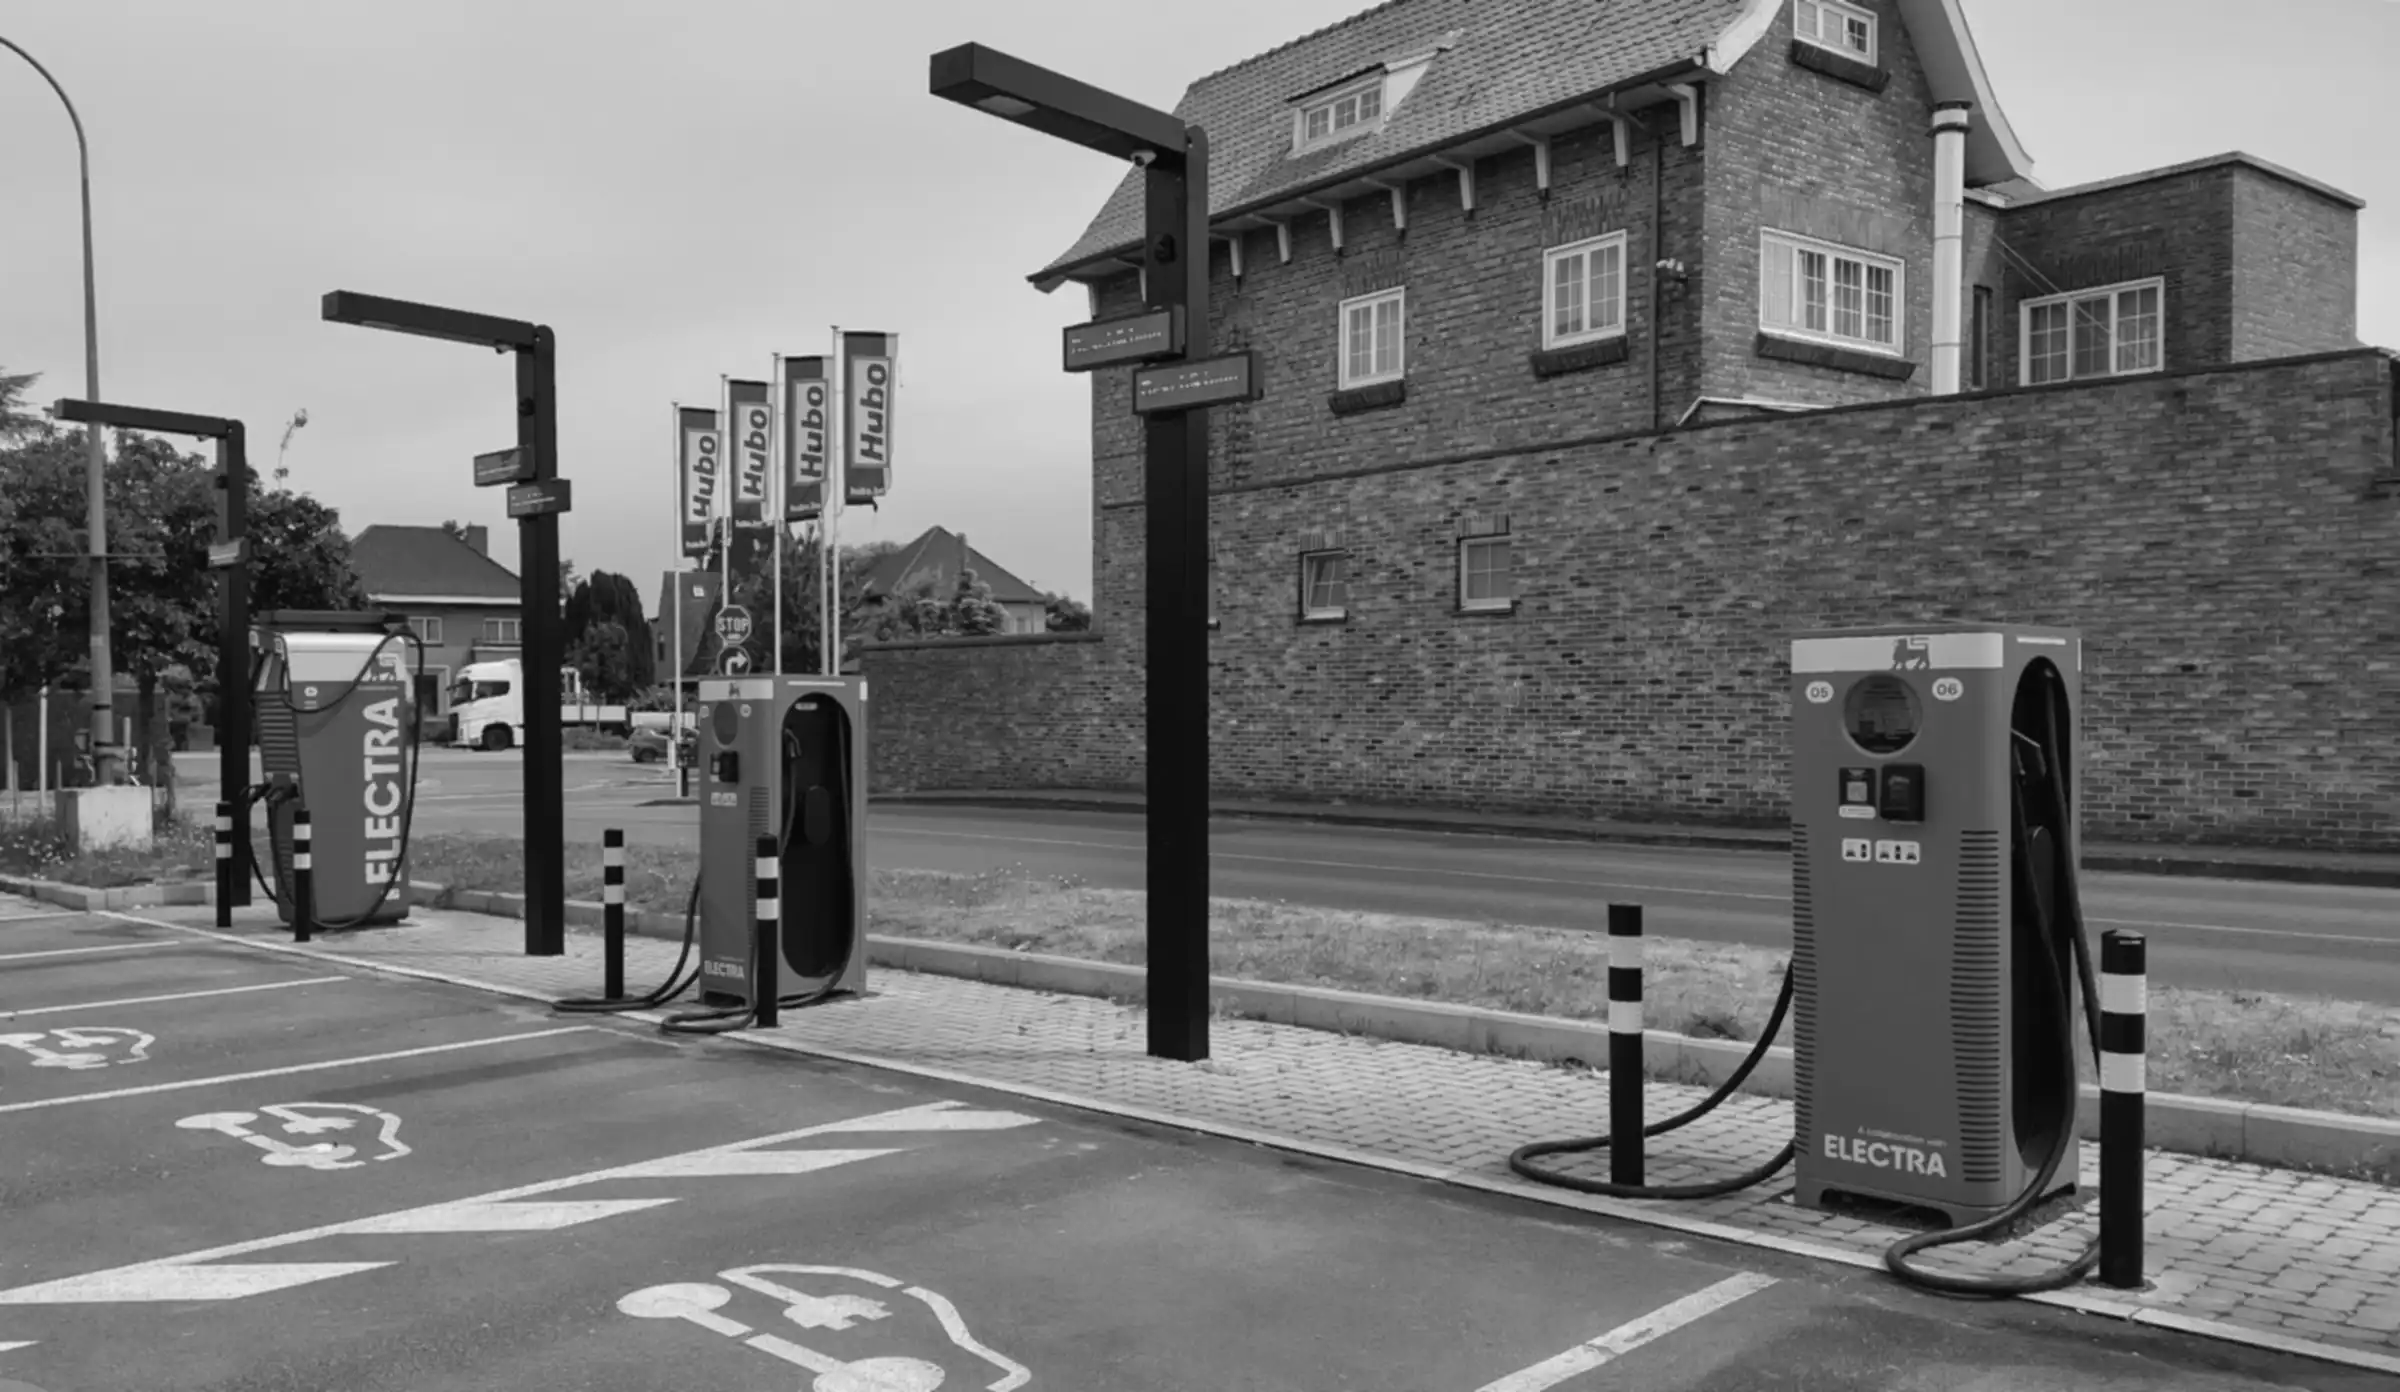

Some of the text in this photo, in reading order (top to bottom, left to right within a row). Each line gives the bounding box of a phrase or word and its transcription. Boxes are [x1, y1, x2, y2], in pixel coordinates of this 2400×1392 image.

[743, 409, 769, 497] Hubo
[800, 386, 825, 478] Hubo
[859, 363, 888, 461] Hubo
[692, 435, 716, 517] Hubo
[715, 616, 749, 632] STOP
[1810, 686, 1829, 699] 05
[1936, 683, 1958, 697] 06
[362, 697, 402, 885] ELECTRA
[1823, 1134, 1948, 1178] ELECTRA
